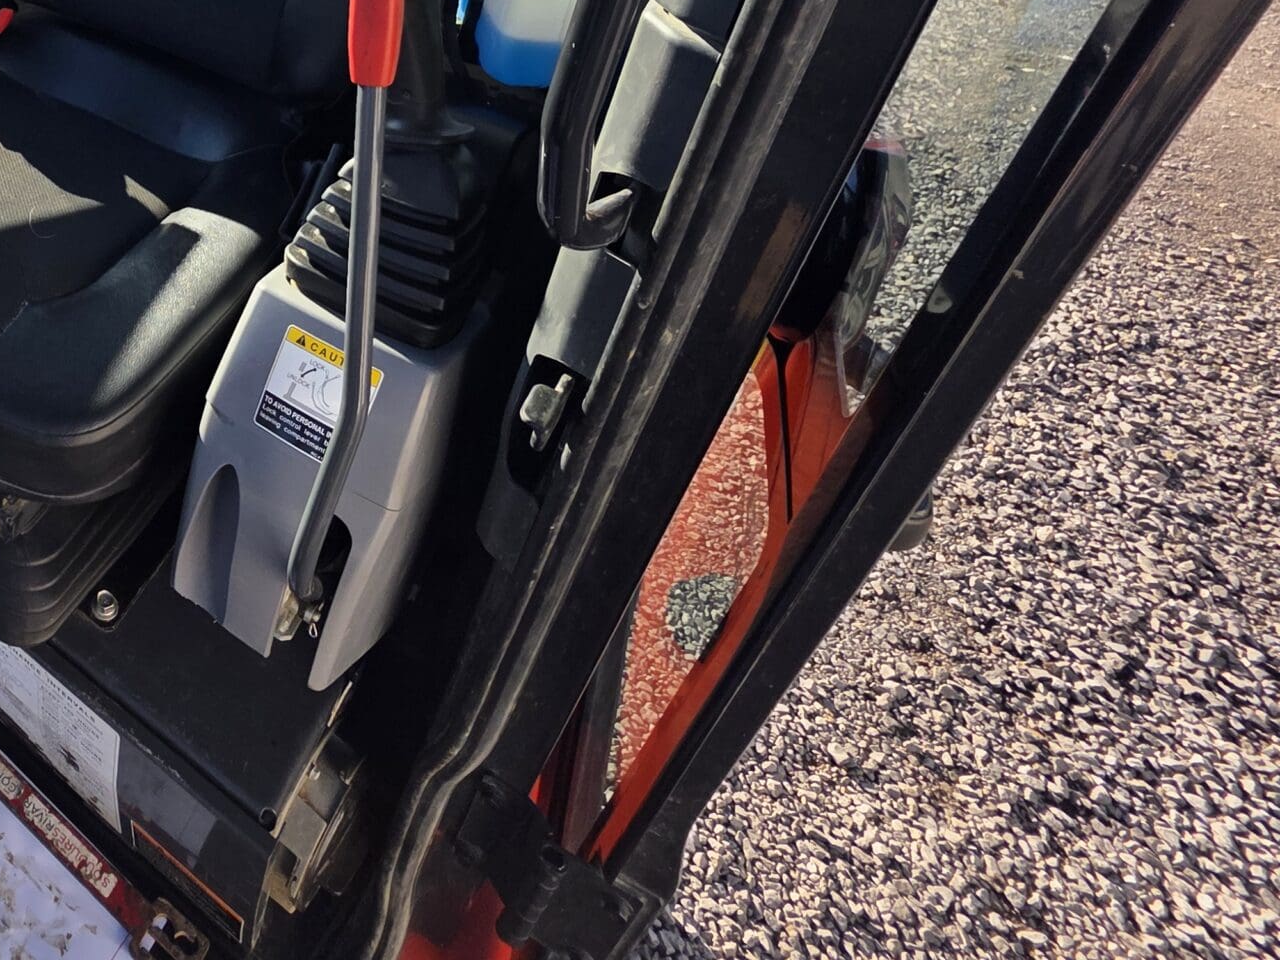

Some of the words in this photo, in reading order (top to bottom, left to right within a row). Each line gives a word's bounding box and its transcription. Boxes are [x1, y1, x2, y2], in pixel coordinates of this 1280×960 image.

[310, 342, 345, 367] CAUT
[262, 403, 277, 416] Lock
[279, 415, 302, 431] control
[303, 427, 321, 442] lever
[264, 394, 273, 405] TO
[272, 400, 292, 416] AVOID
[291, 411, 325, 436] PERSONAL
